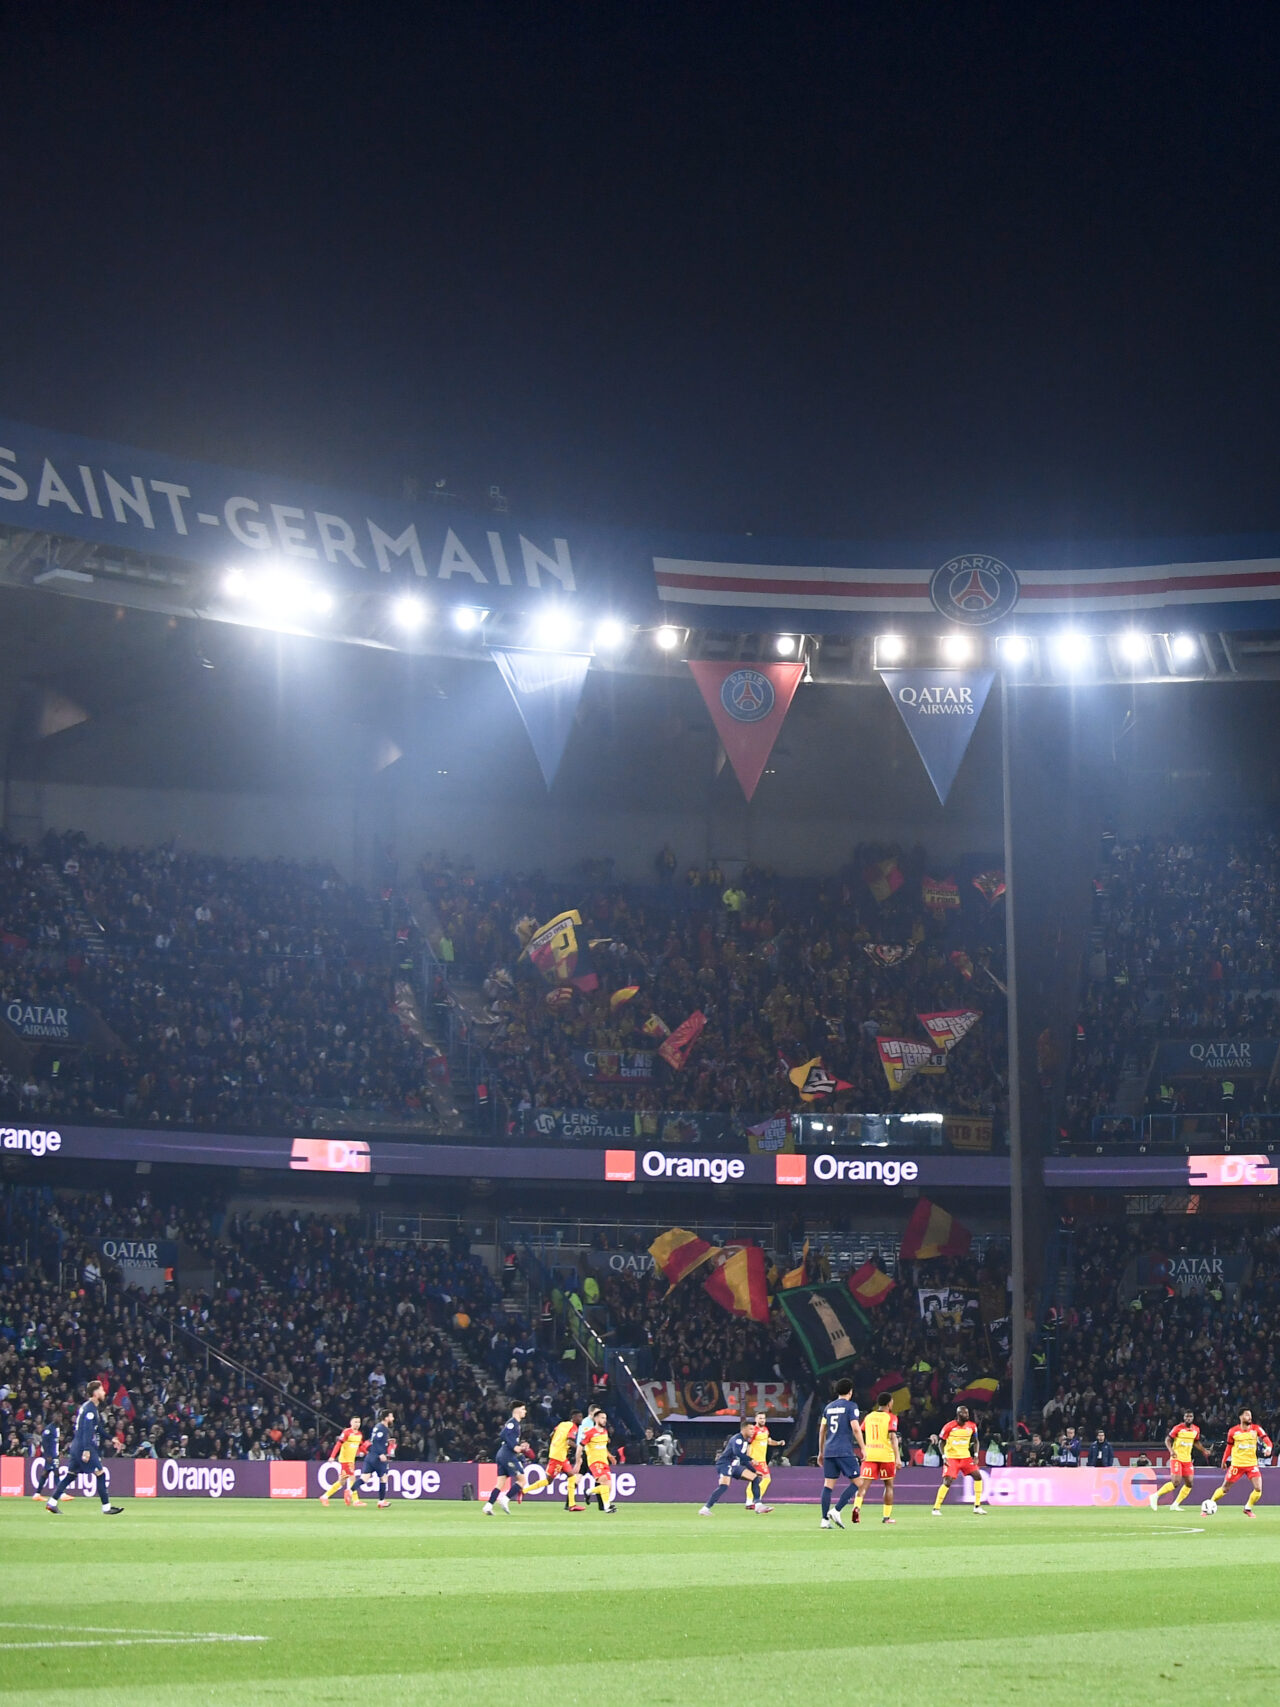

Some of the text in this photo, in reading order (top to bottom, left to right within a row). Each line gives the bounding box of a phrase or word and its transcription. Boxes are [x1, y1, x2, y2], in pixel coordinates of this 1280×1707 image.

[0, 446, 577, 591] SAINT-GERMAIN
[946, 557, 1003, 575] PARIS
[729, 672, 765, 685] PARIS
[899, 687, 973, 706] QATAR
[918, 704, 974, 714] AIRWAYS
[7, 1004, 68, 1025] QATAR
[22, 1024, 69, 1037] AIRWAYS
[620, 1054, 652, 1067] LNS
[1189, 1043, 1251, 1061] QATAR
[1205, 1058, 1252, 1068] AIRWAYS
[563, 1114, 598, 1124] LENS
[563, 1125, 631, 1137] CAPITALE
[642, 1151, 745, 1183] Orange
[814, 1155, 918, 1186] Orange
[103, 1241, 158, 1260] QATAR
[609, 1255, 657, 1272] QATA
[1176, 1275, 1224, 1284] AIRWAS
[830, 1415, 839, 1433] 5
[872, 1424, 879, 1441] 11
[162, 1459, 235, 1497] Orange
[271, 1487, 304, 1497] orange
[1093, 1468, 1158, 1506] 5G
